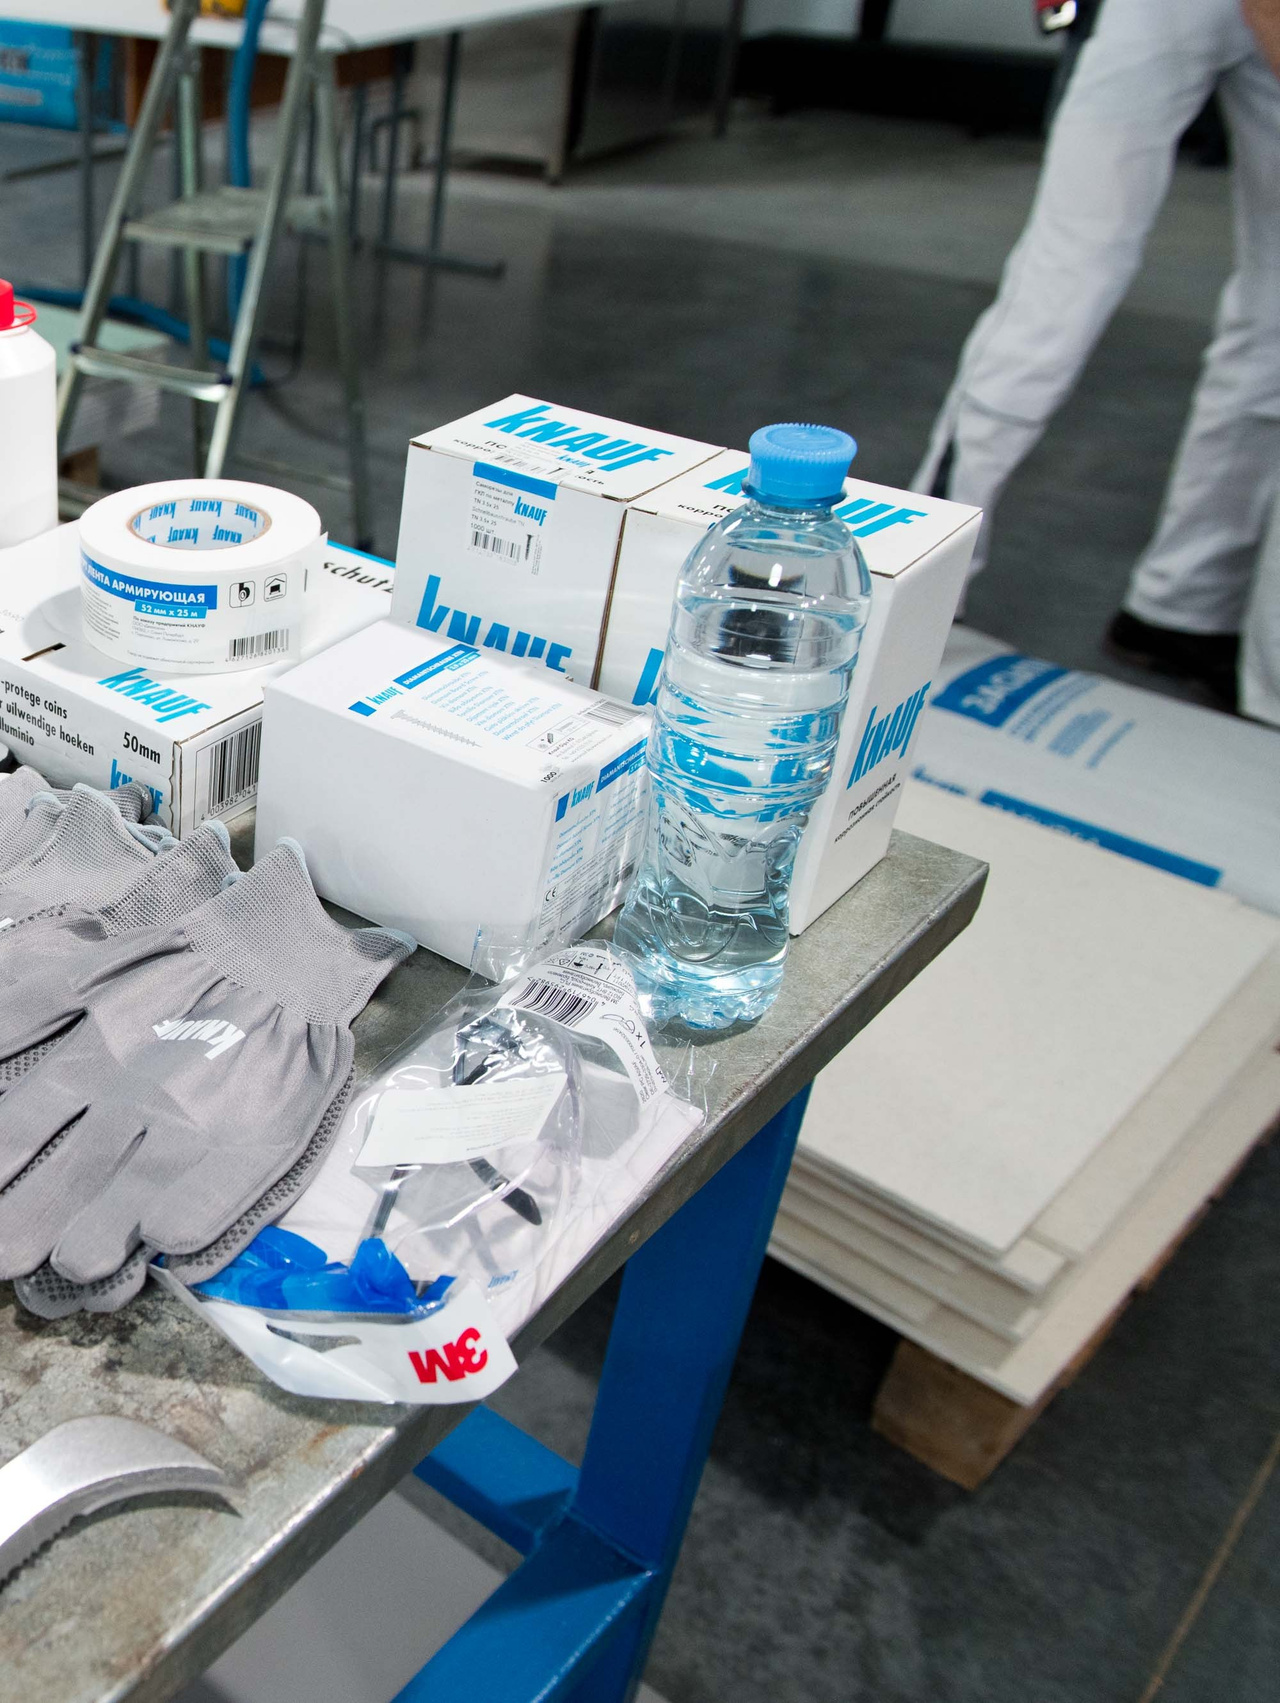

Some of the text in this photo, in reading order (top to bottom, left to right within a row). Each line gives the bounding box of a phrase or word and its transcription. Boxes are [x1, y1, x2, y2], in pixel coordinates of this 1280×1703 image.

[483, 405, 674, 472] KNAUF
[514, 496, 548, 526] KNAUF
[111, 578, 206, 604] АРМИРУЮЩАЯ
[141, 604, 152, 613] 52
[177, 609, 189, 617] 25
[44, 699, 68, 720] coins
[96, 667, 213, 723] KNAUF
[366, 686, 403, 705] KNAUF
[59, 725, 95, 756] hoeken
[122, 731, 161, 764] 50mm
[846, 680, 932, 791] KNAUF
[540, 771, 557, 783] 1000
[848, 772, 897, 822] ПОВЫШЕННАЯ
[151, 1019, 247, 1060] KNAUF
[408, 1327, 488, 1384] 3M
